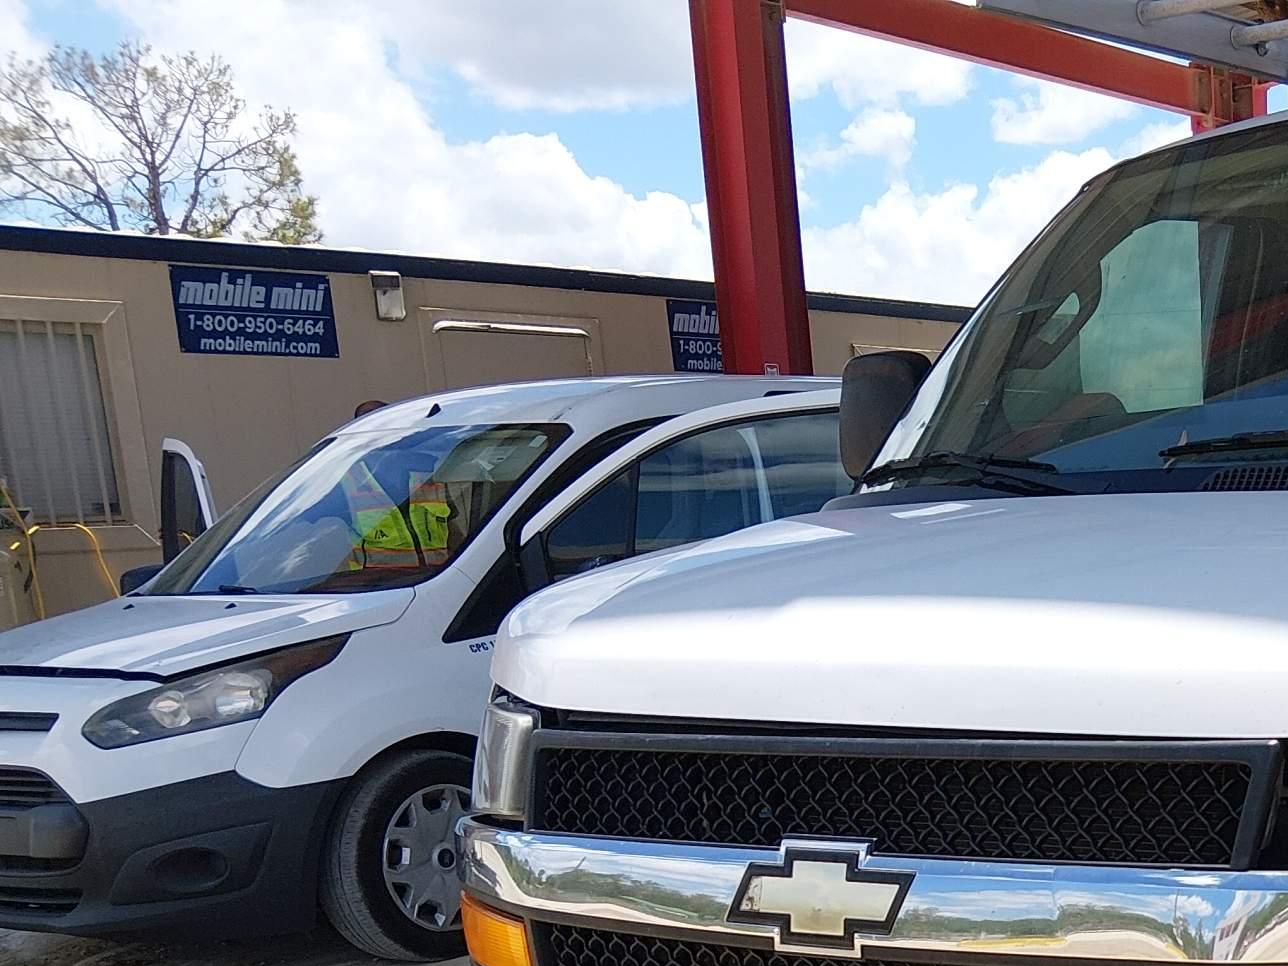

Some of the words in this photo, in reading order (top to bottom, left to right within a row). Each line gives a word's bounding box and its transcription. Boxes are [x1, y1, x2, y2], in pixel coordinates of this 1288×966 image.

[178, 271, 266, 309] mobile
[270, 282, 325, 312] mini
[187, 313, 325, 336] 1-800-950-6464
[200, 335, 321, 355] mobilemini.com
[469, 641, 489, 653] CPC
